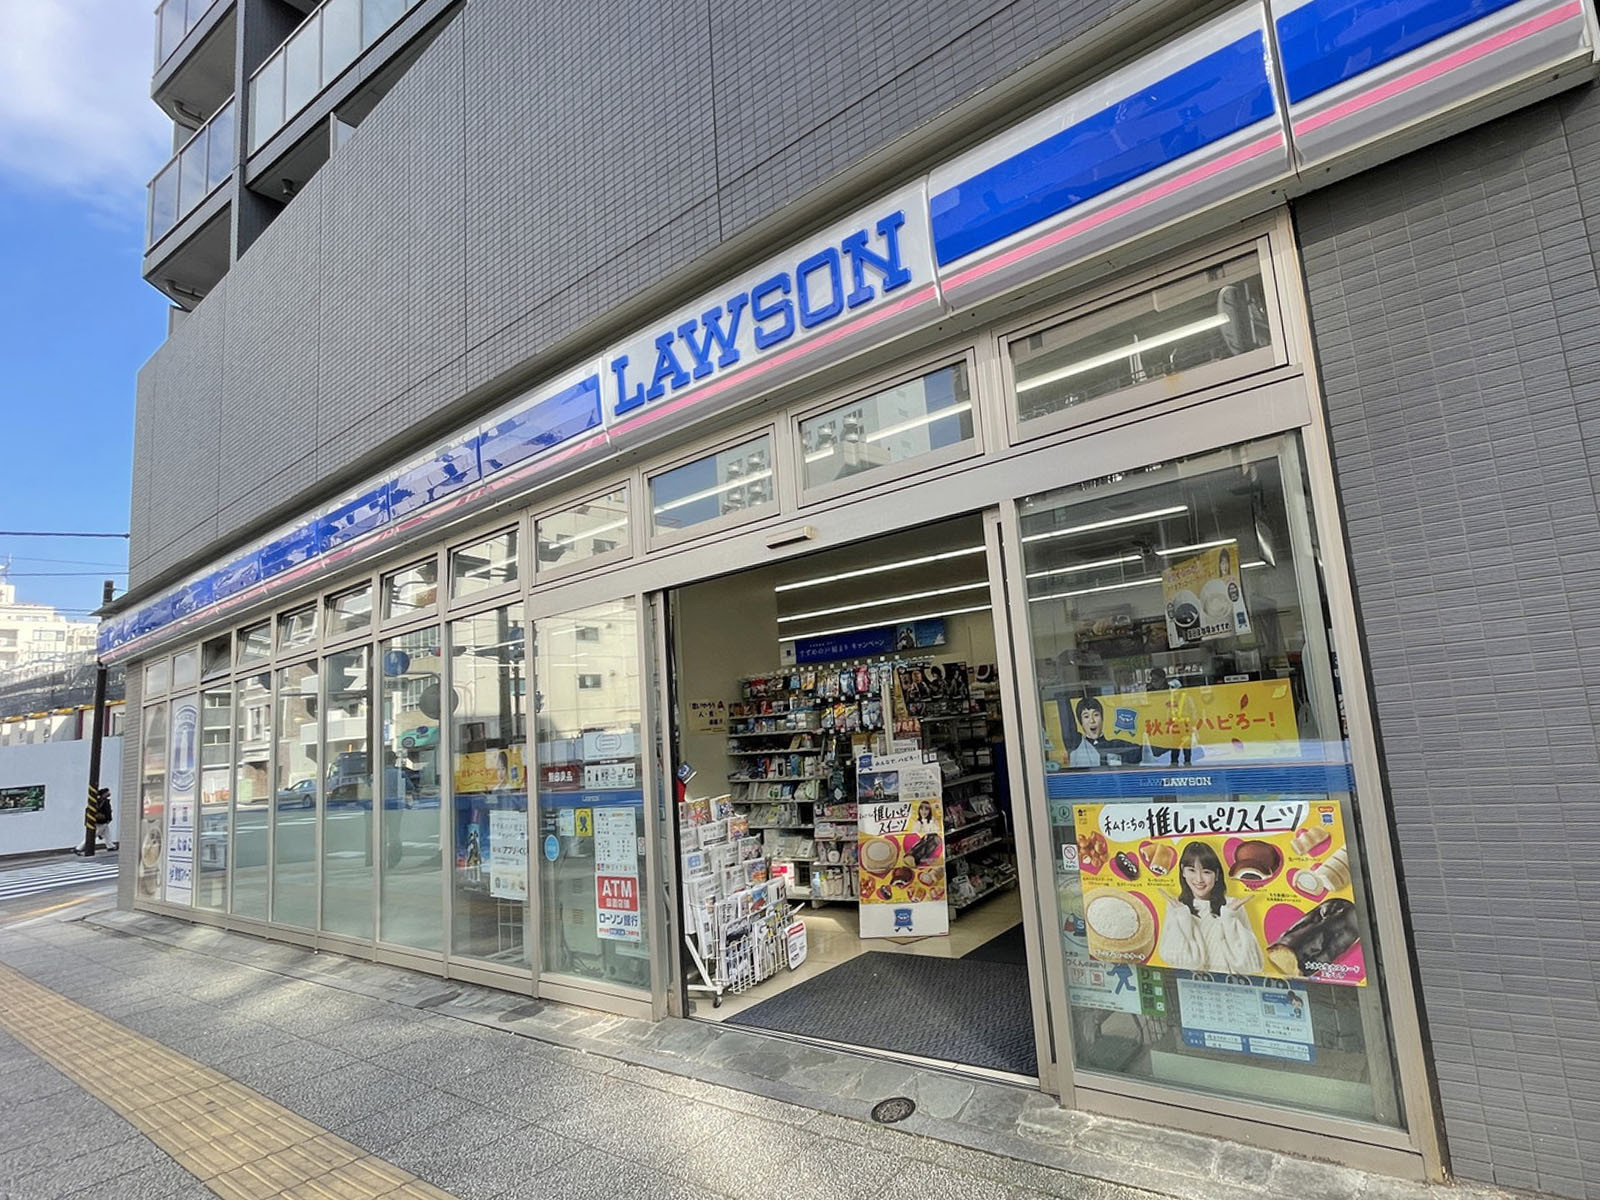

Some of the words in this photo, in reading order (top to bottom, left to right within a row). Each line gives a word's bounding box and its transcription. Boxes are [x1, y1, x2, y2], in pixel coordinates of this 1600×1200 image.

[611, 210, 912, 416] LAWSON
[1163, 776, 1212, 787] LAWSON
[880, 819, 907, 833] スイーツ
[602, 879, 632, 898] ATM
[599, 913, 638, 927] ローソン銀行
